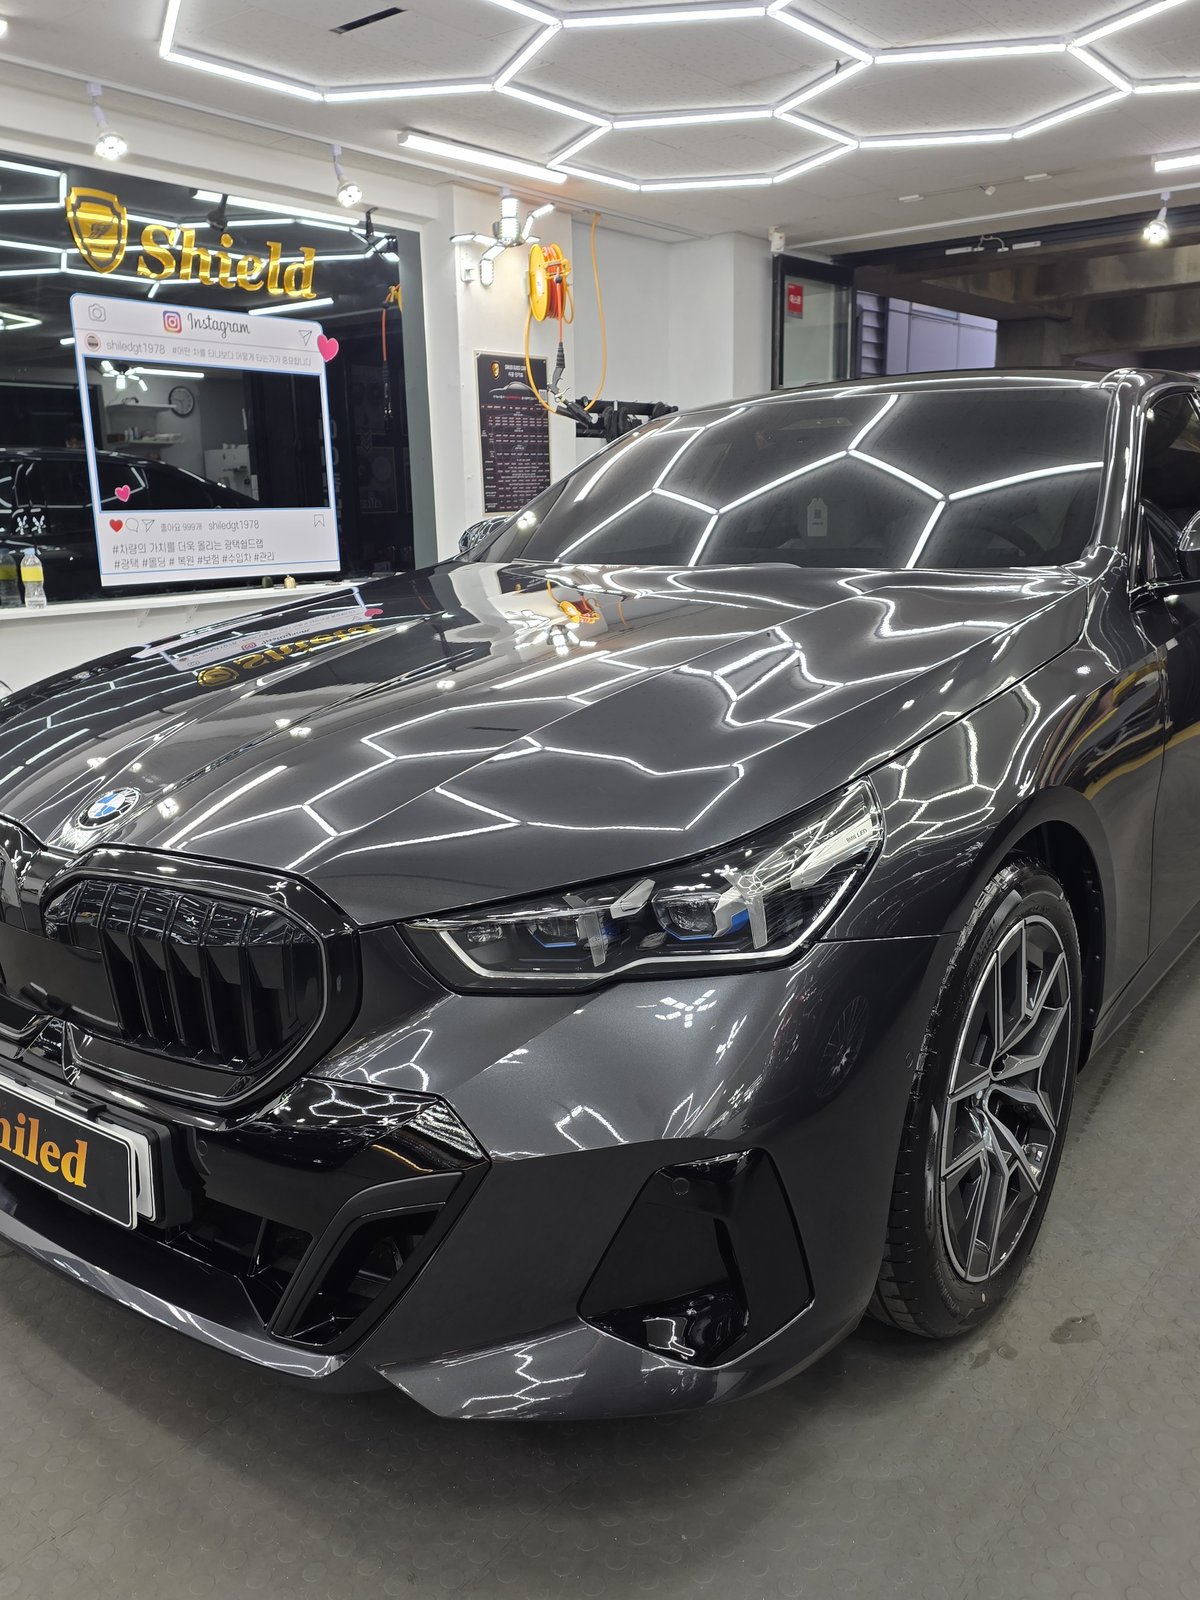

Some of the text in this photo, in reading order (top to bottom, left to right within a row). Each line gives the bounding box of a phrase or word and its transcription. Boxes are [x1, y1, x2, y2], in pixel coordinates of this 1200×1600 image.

[137, 224, 317, 299] Shield
[187, 312, 251, 339] Instagram
[106, 340, 166, 357] shiledgt1978
[208, 519, 260, 532] shiledgt1978
[112, 542, 147, 555] #차량의
[149, 541, 176, 553] 가치를
[178, 541, 195, 552] 더욱
[197, 554, 220, 565] #보험
[222, 552, 252, 564] #수입차
